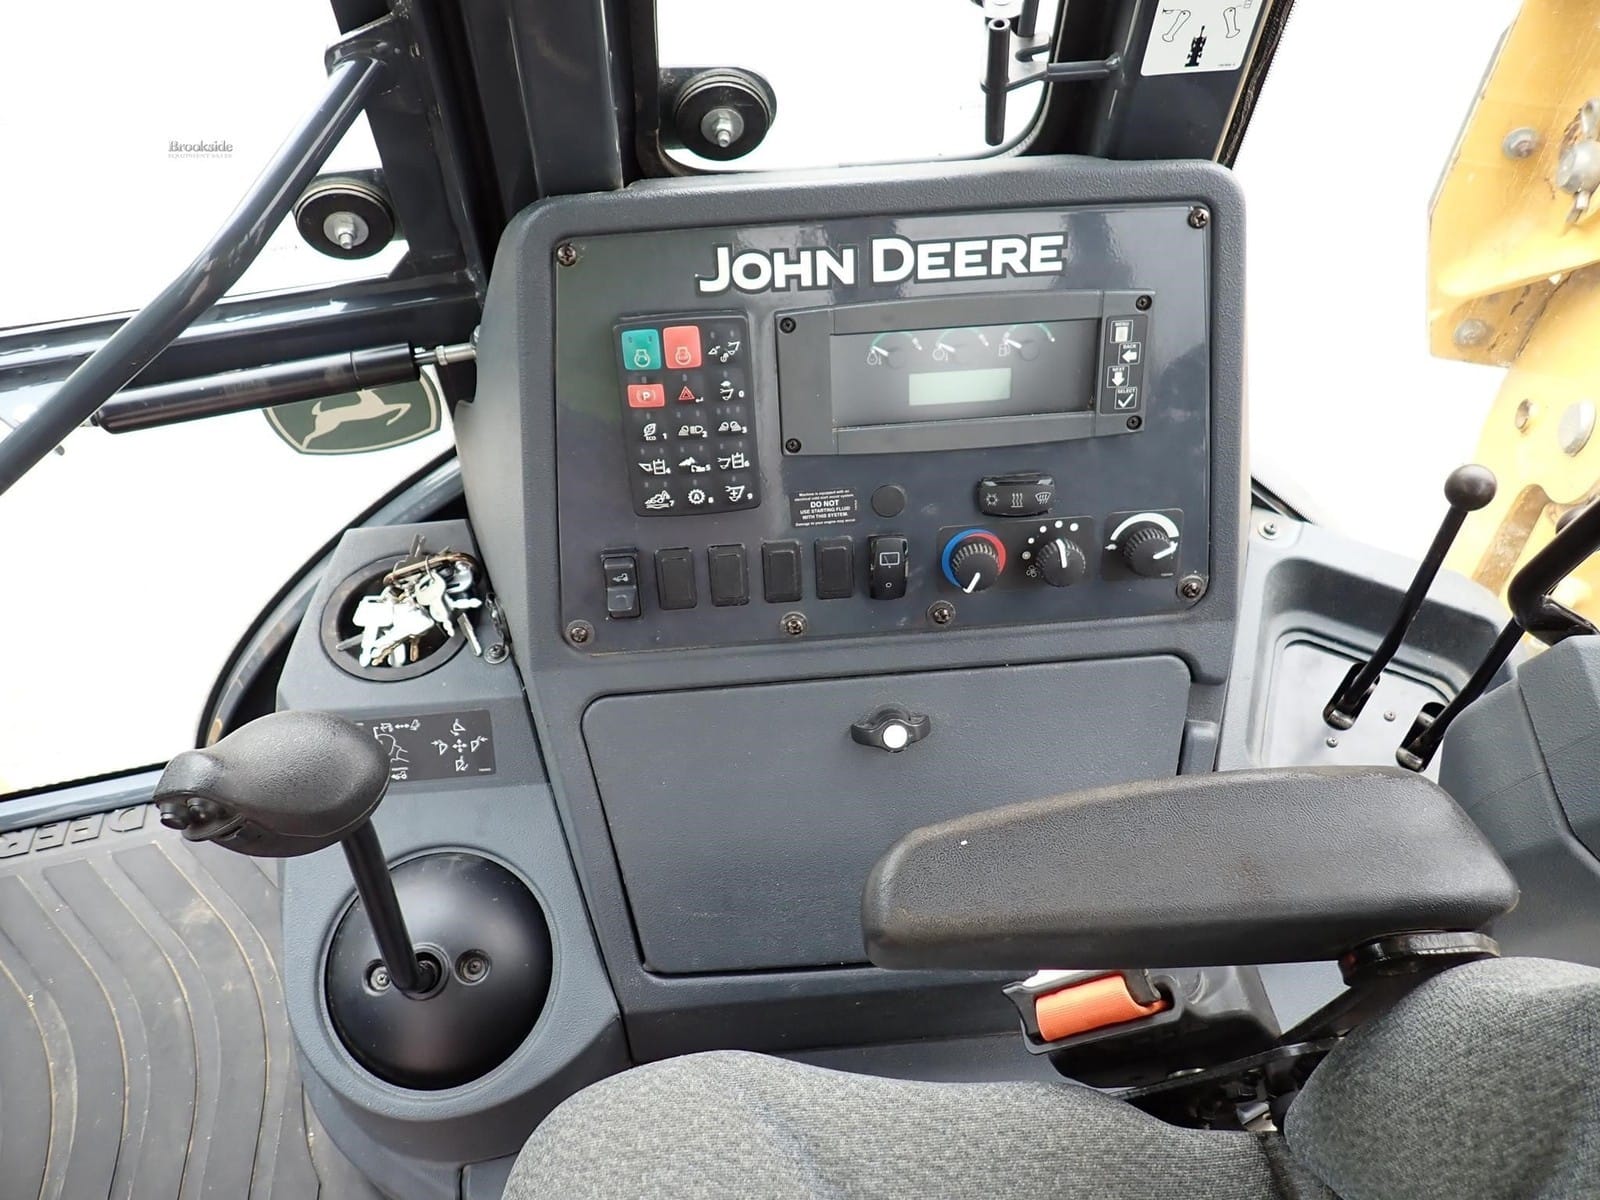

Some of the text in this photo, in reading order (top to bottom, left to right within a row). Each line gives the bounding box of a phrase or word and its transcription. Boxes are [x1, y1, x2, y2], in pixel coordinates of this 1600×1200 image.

[697, 234, 1065, 293] JOHN DEERE
[823, 499, 840, 507] NOT
